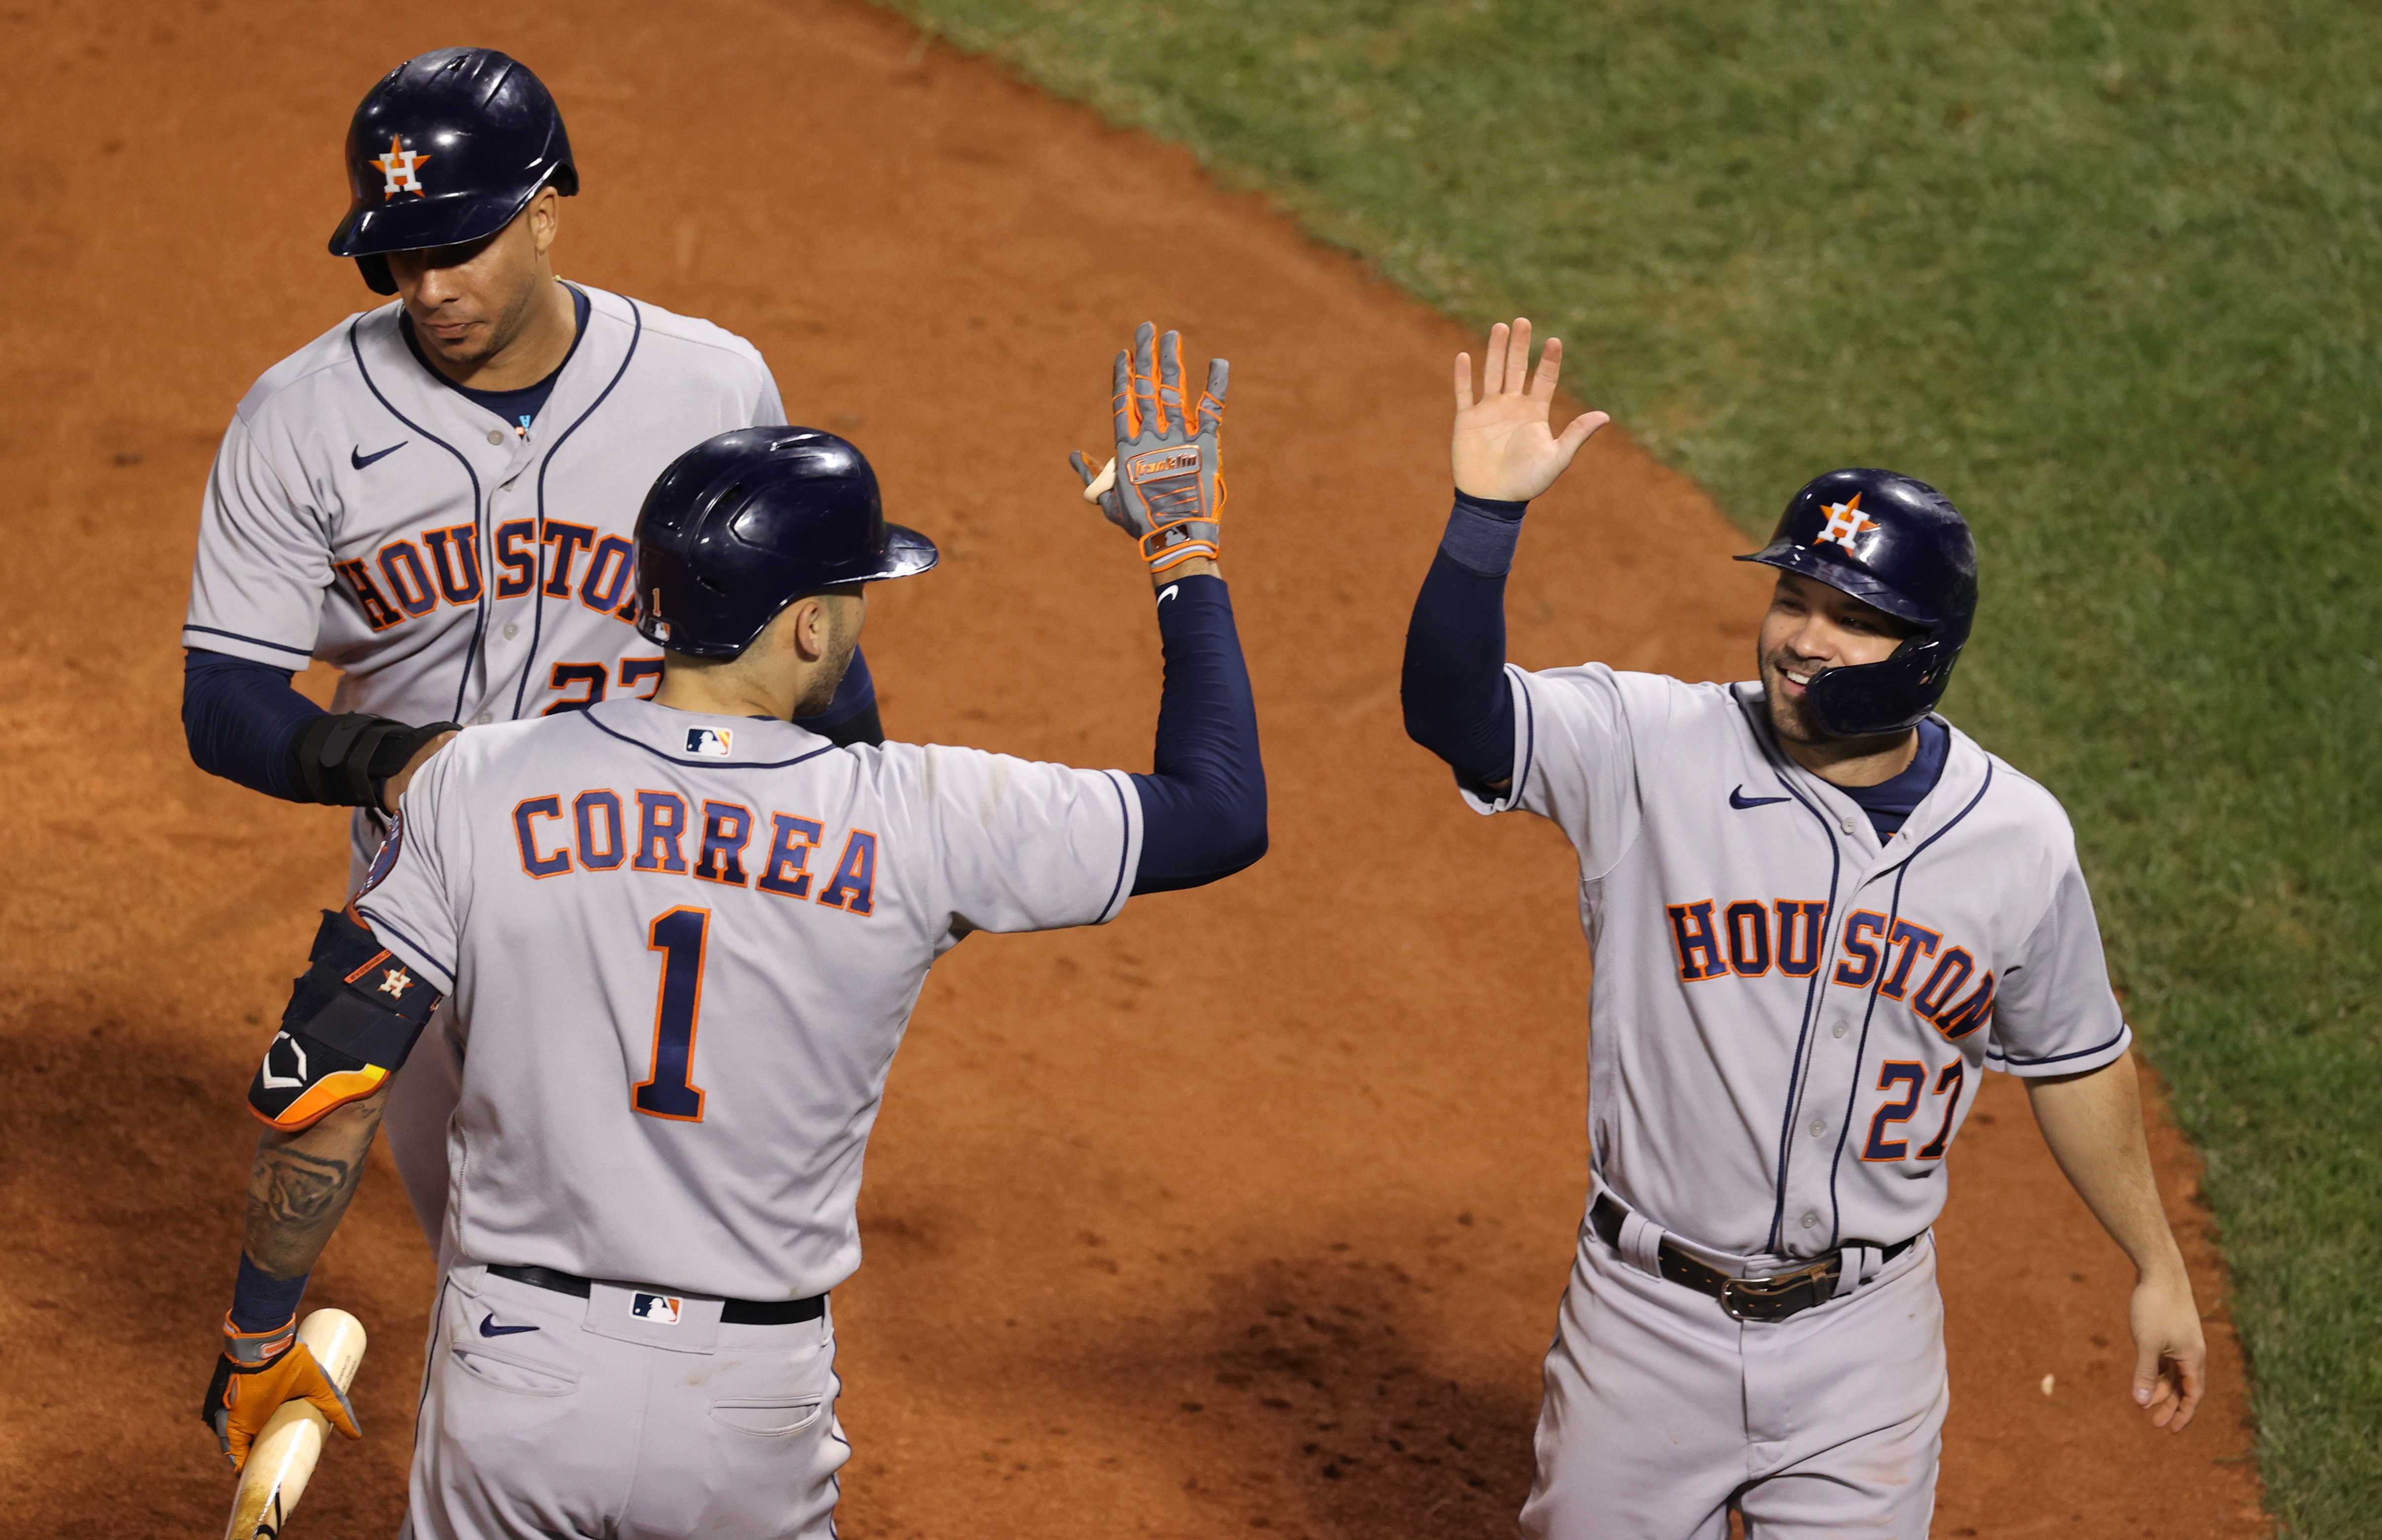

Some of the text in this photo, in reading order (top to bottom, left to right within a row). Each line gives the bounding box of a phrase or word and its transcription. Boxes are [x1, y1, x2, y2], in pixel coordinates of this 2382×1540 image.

[379, 150, 422, 193] H
[1817, 502, 1870, 551] H
[333, 517, 638, 632] HOUSTO
[652, 588, 662, 617] 1
[511, 788, 877, 917] CORREA
[379, 969, 411, 998] H
[631, 905, 711, 1123] 1
[1859, 1054, 1964, 1162] 27
